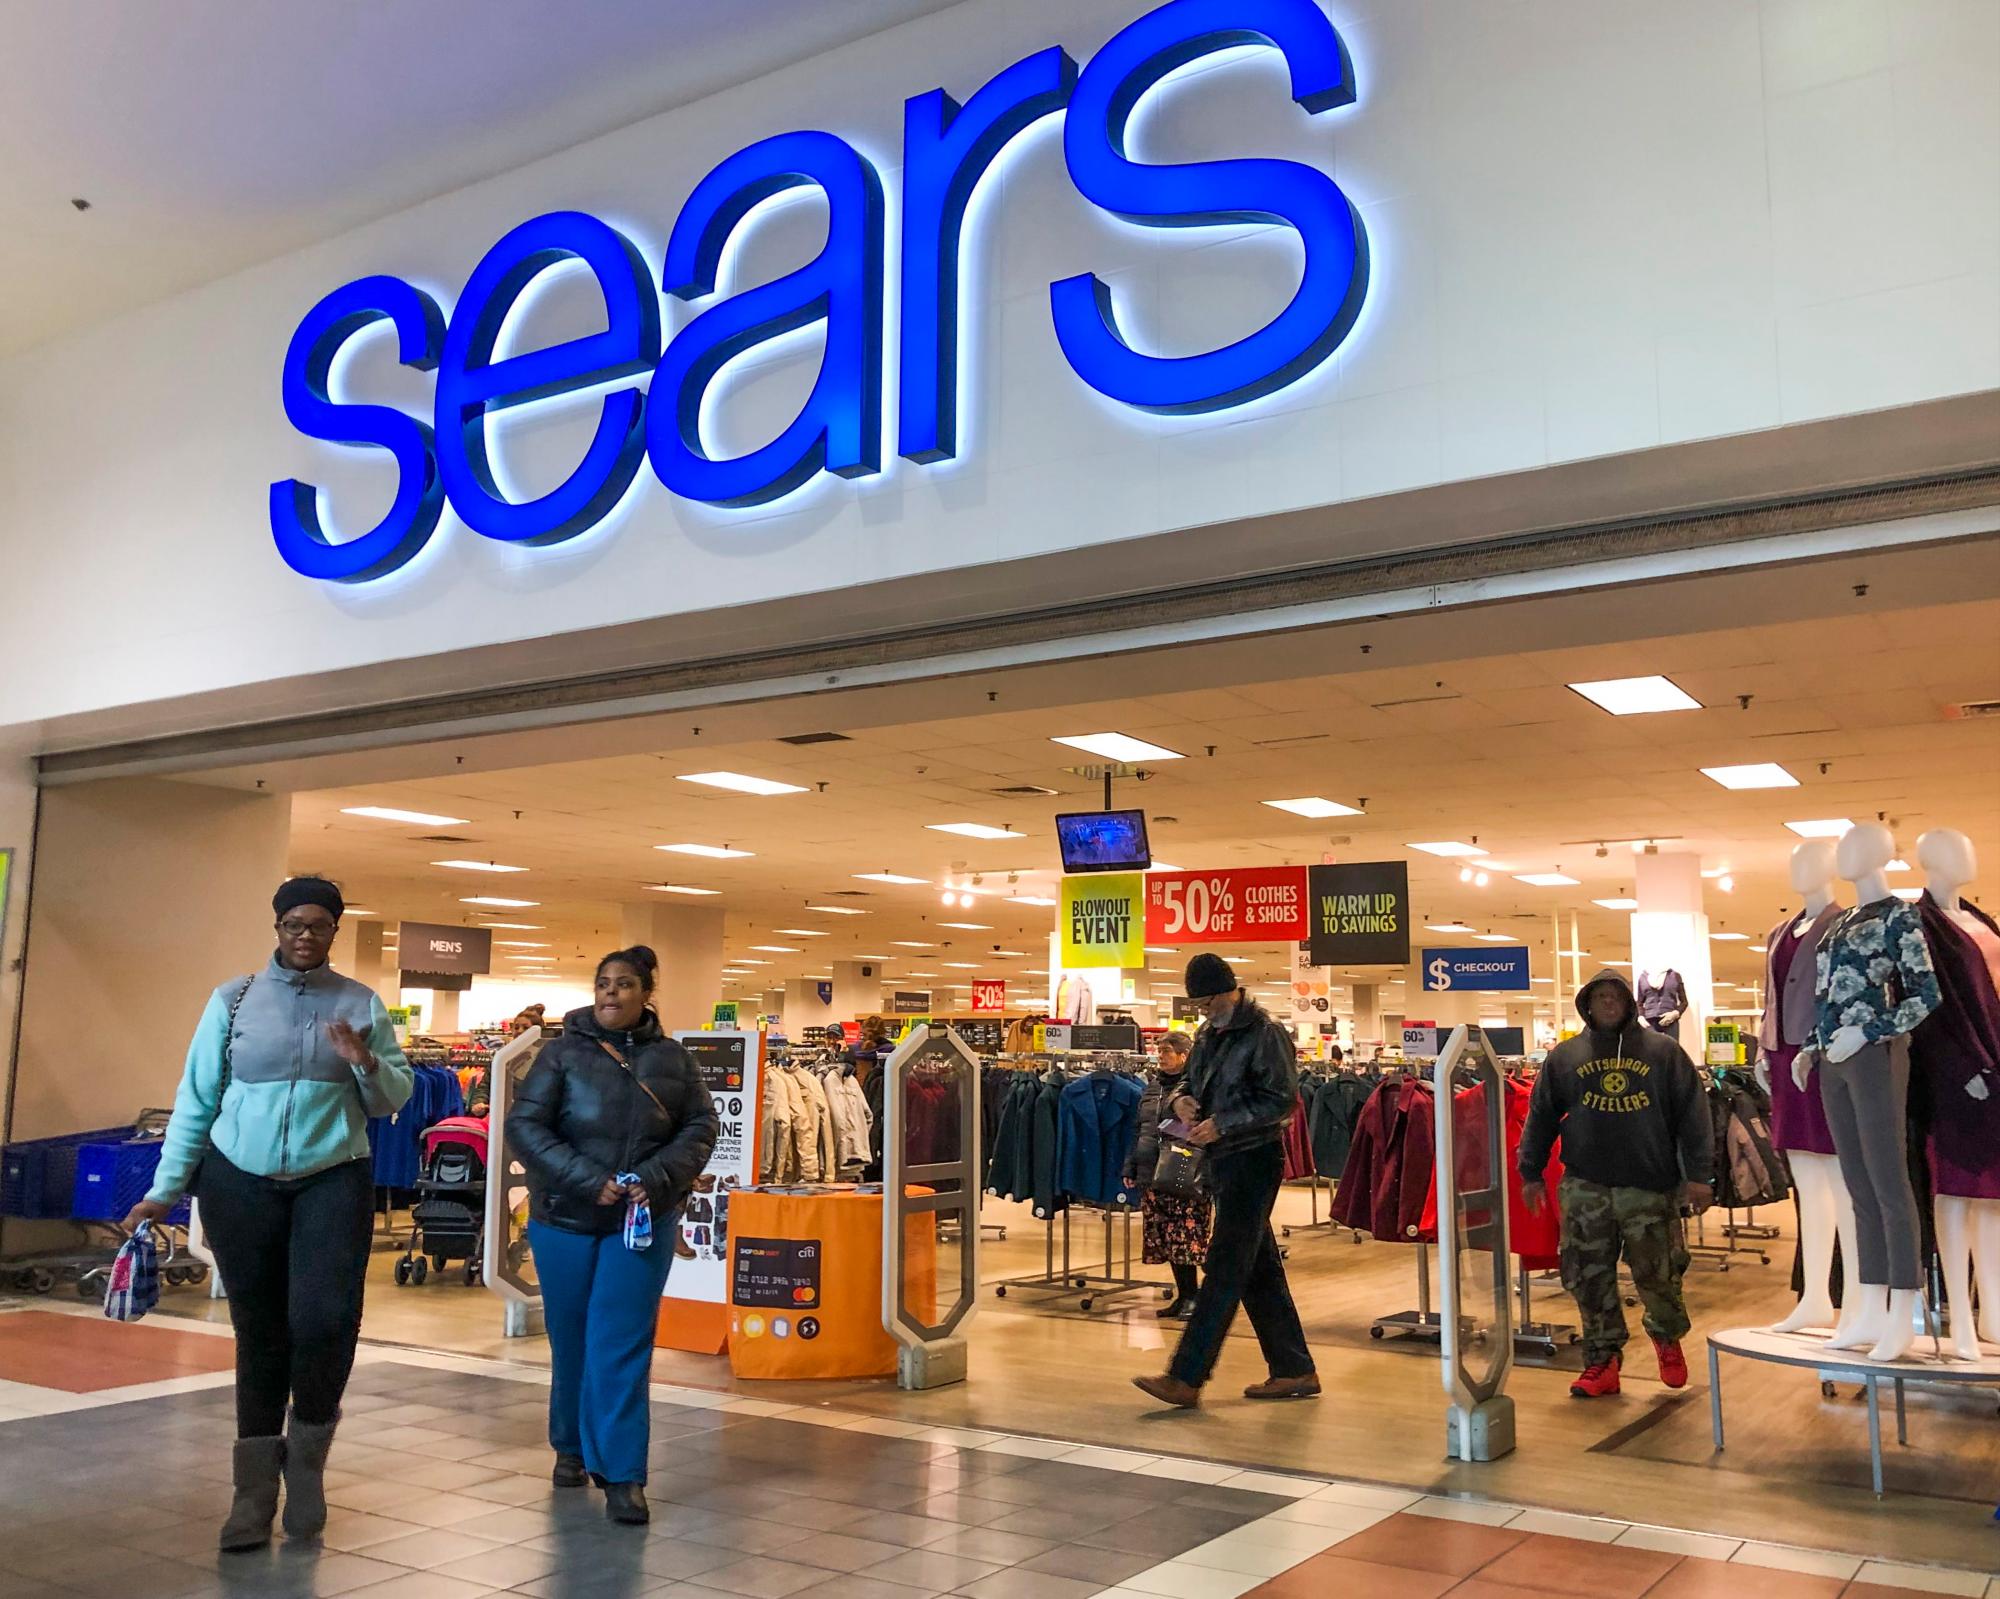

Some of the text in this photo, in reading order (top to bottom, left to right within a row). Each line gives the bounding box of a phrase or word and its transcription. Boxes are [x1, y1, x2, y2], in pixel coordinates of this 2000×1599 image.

[270, 0, 1369, 582] sears
[1152, 882, 1162, 893] UP
[1245, 886, 1298, 904] CLOTHES
[1072, 898, 1131, 917] BLOWOUT
[1152, 894, 1161, 905] TO
[1164, 878, 1234, 934] 50%
[1322, 893, 1396, 916] WARM UP
[1211, 914, 1234, 932] OFF
[1245, 905, 1298, 924] & SHOES
[1322, 914, 1397, 934] TO SAVINGS
[1072, 916, 1131, 944] EVENT
[429, 939, 462, 953] MEN'S
[1454, 962, 1515, 972] CHECKOUT
[1582, 1091, 1650, 1113] STEELERS
[798, 1246, 815, 1257] citi
